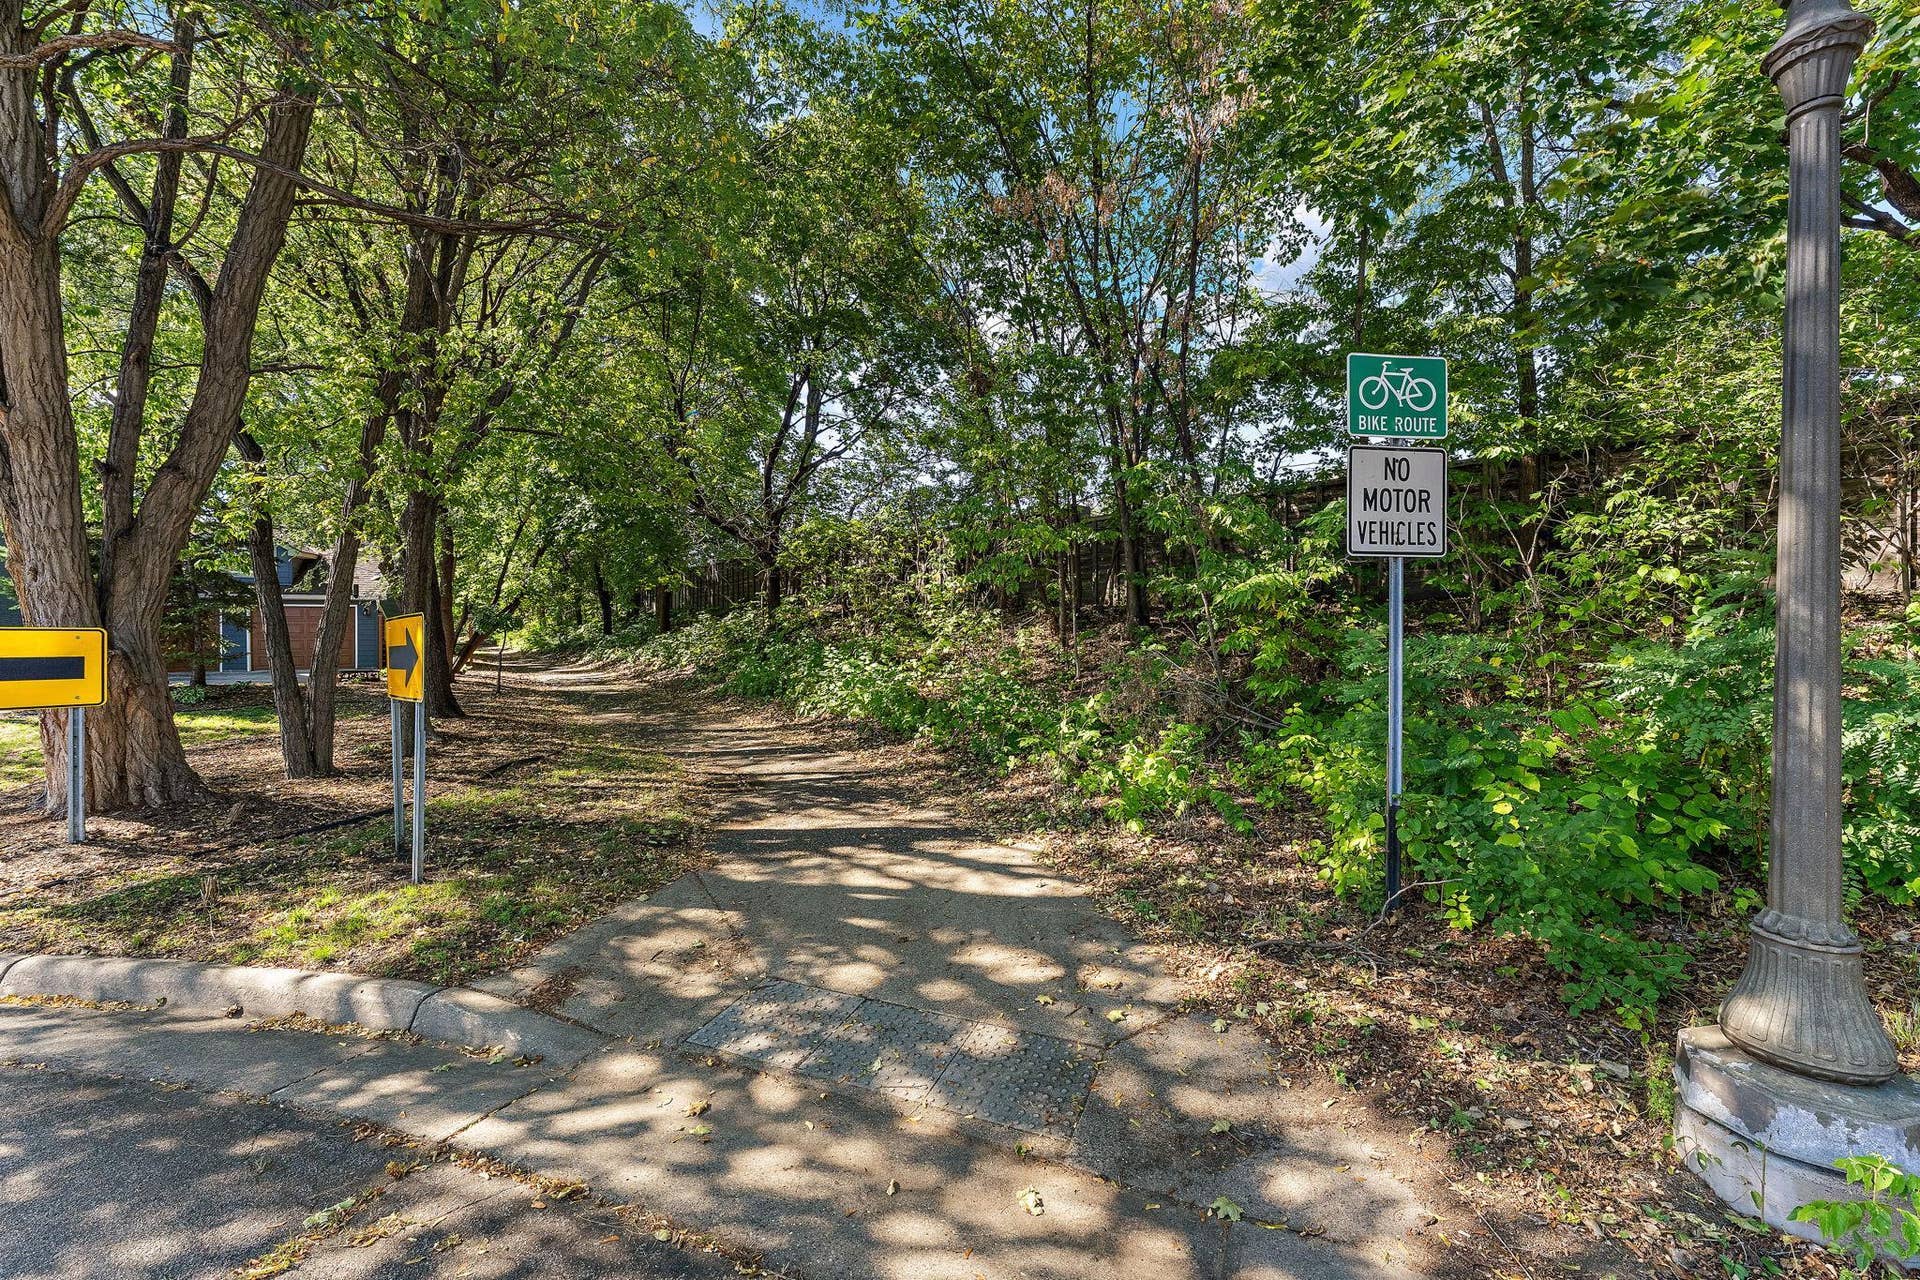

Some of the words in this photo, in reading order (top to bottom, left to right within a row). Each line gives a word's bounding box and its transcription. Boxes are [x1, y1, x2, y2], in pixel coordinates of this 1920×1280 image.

[1358, 415, 1388, 431] BIKE
[1394, 416, 1437, 433] ROUTE
[1384, 456, 1410, 482] NO
[1363, 487, 1431, 513] MOTOR
[1357, 520, 1437, 546] VEHICLES
